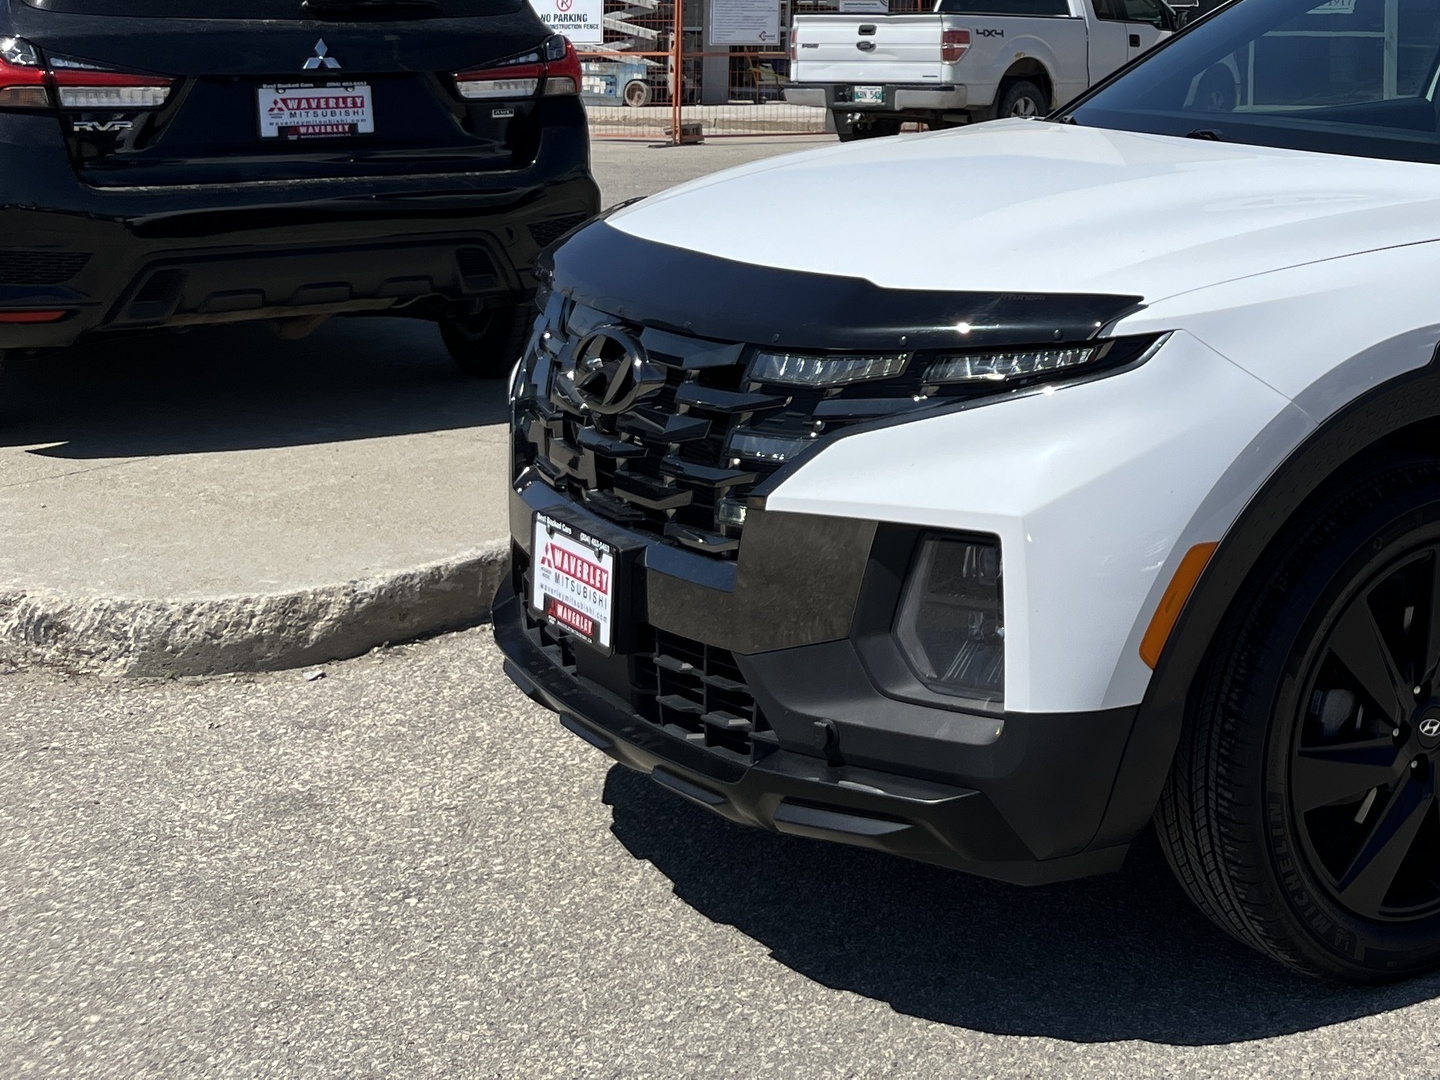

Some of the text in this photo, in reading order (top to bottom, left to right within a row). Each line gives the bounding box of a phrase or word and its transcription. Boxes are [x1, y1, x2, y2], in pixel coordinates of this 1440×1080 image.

[541, 14, 588, 22] NO PARKING
[287, 97, 363, 109] WAVERLEY
[289, 110, 365, 118] MITSUBISHI
[73, 121, 134, 131] RVR
[269, 118, 366, 126] waverleymitsubishi.com
[300, 125, 350, 133] WAVERLEY
[554, 546, 608, 591] WAVERLEY
[554, 572, 607, 610] MITSUBISHI
[540, 582, 608, 623] waverleymitsubishi.com
[557, 603, 593, 634] WAVERLEY
